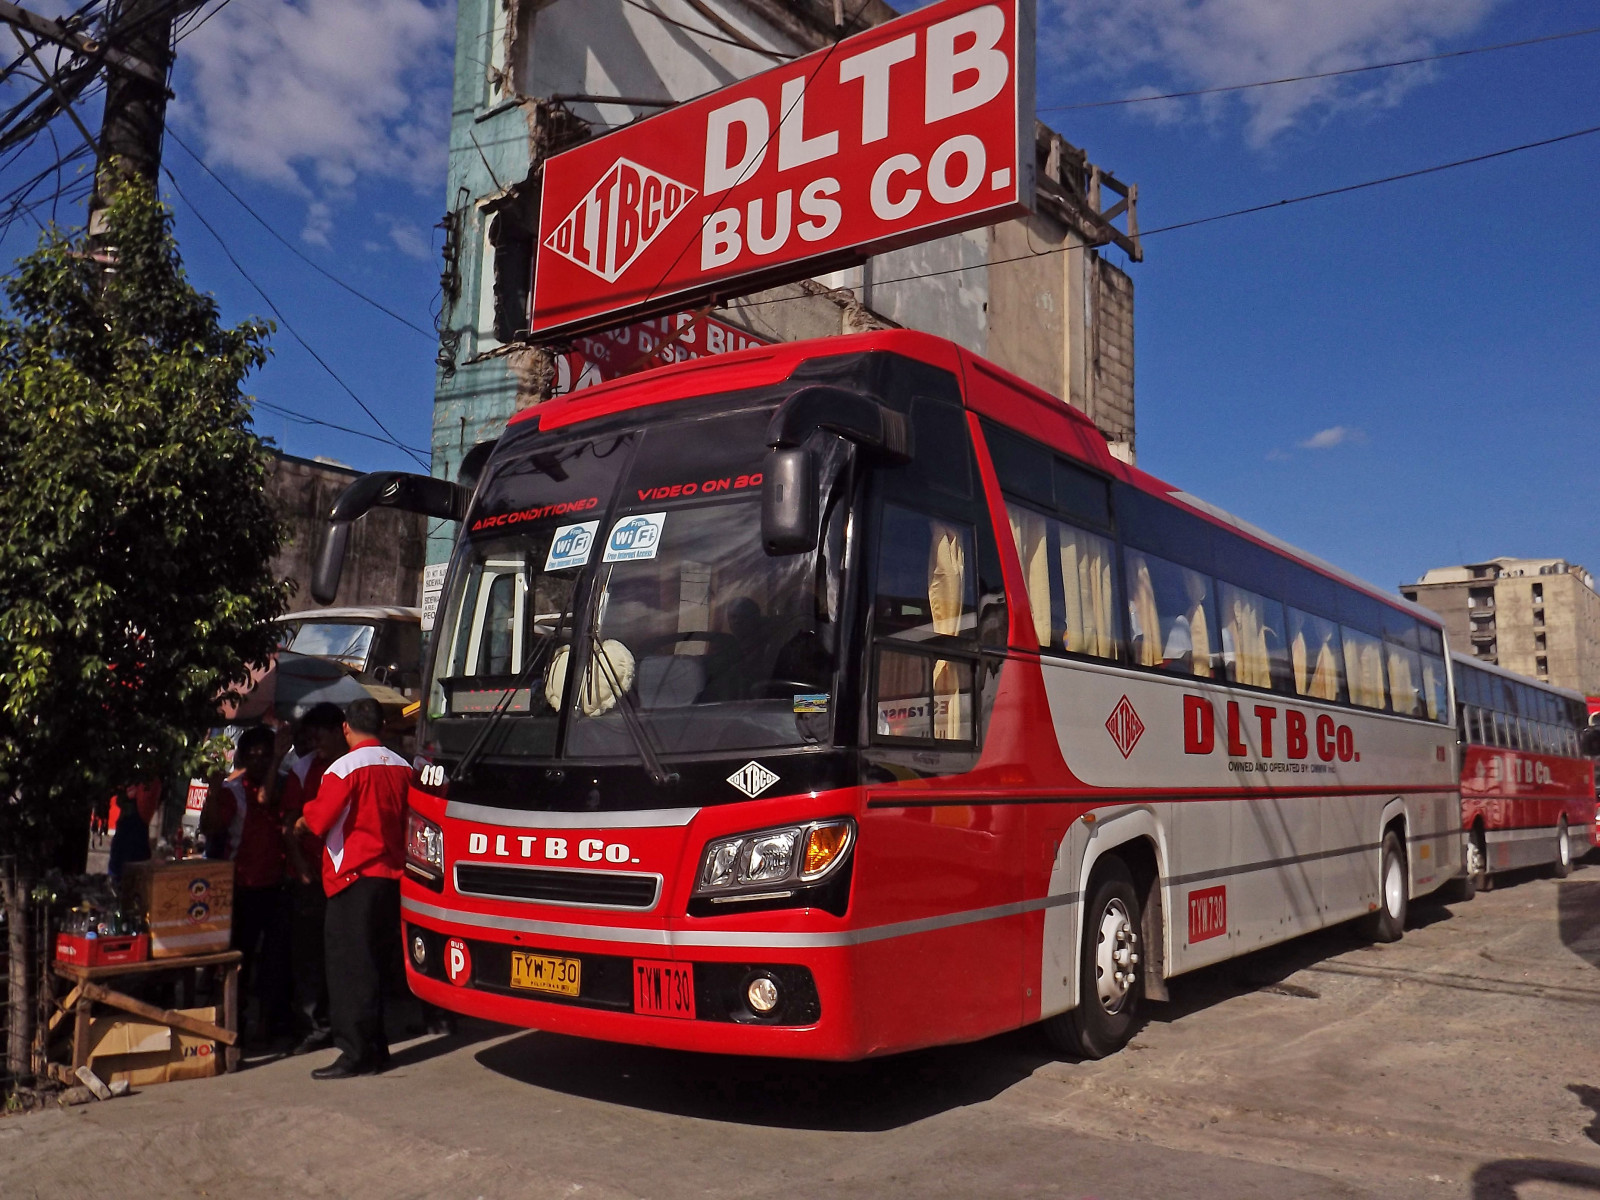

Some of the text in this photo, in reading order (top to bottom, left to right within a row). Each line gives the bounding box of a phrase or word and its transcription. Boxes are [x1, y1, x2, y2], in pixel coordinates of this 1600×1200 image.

[703, 4, 1009, 197] DLTB
[701, 134, 1010, 271] BUS CO.
[637, 482, 697, 501] VIDEO
[701, 478, 732, 493] ON
[472, 497, 598, 531] AIRCONDITIONED
[421, 764, 444, 786] 419
[1228, 761, 1253, 772] OWNED
[1255, 762, 1268, 772] AND
[1269, 763, 1300, 773] OPERATED
[450, 940, 464, 949] BUS
[450, 948, 465, 980] P
